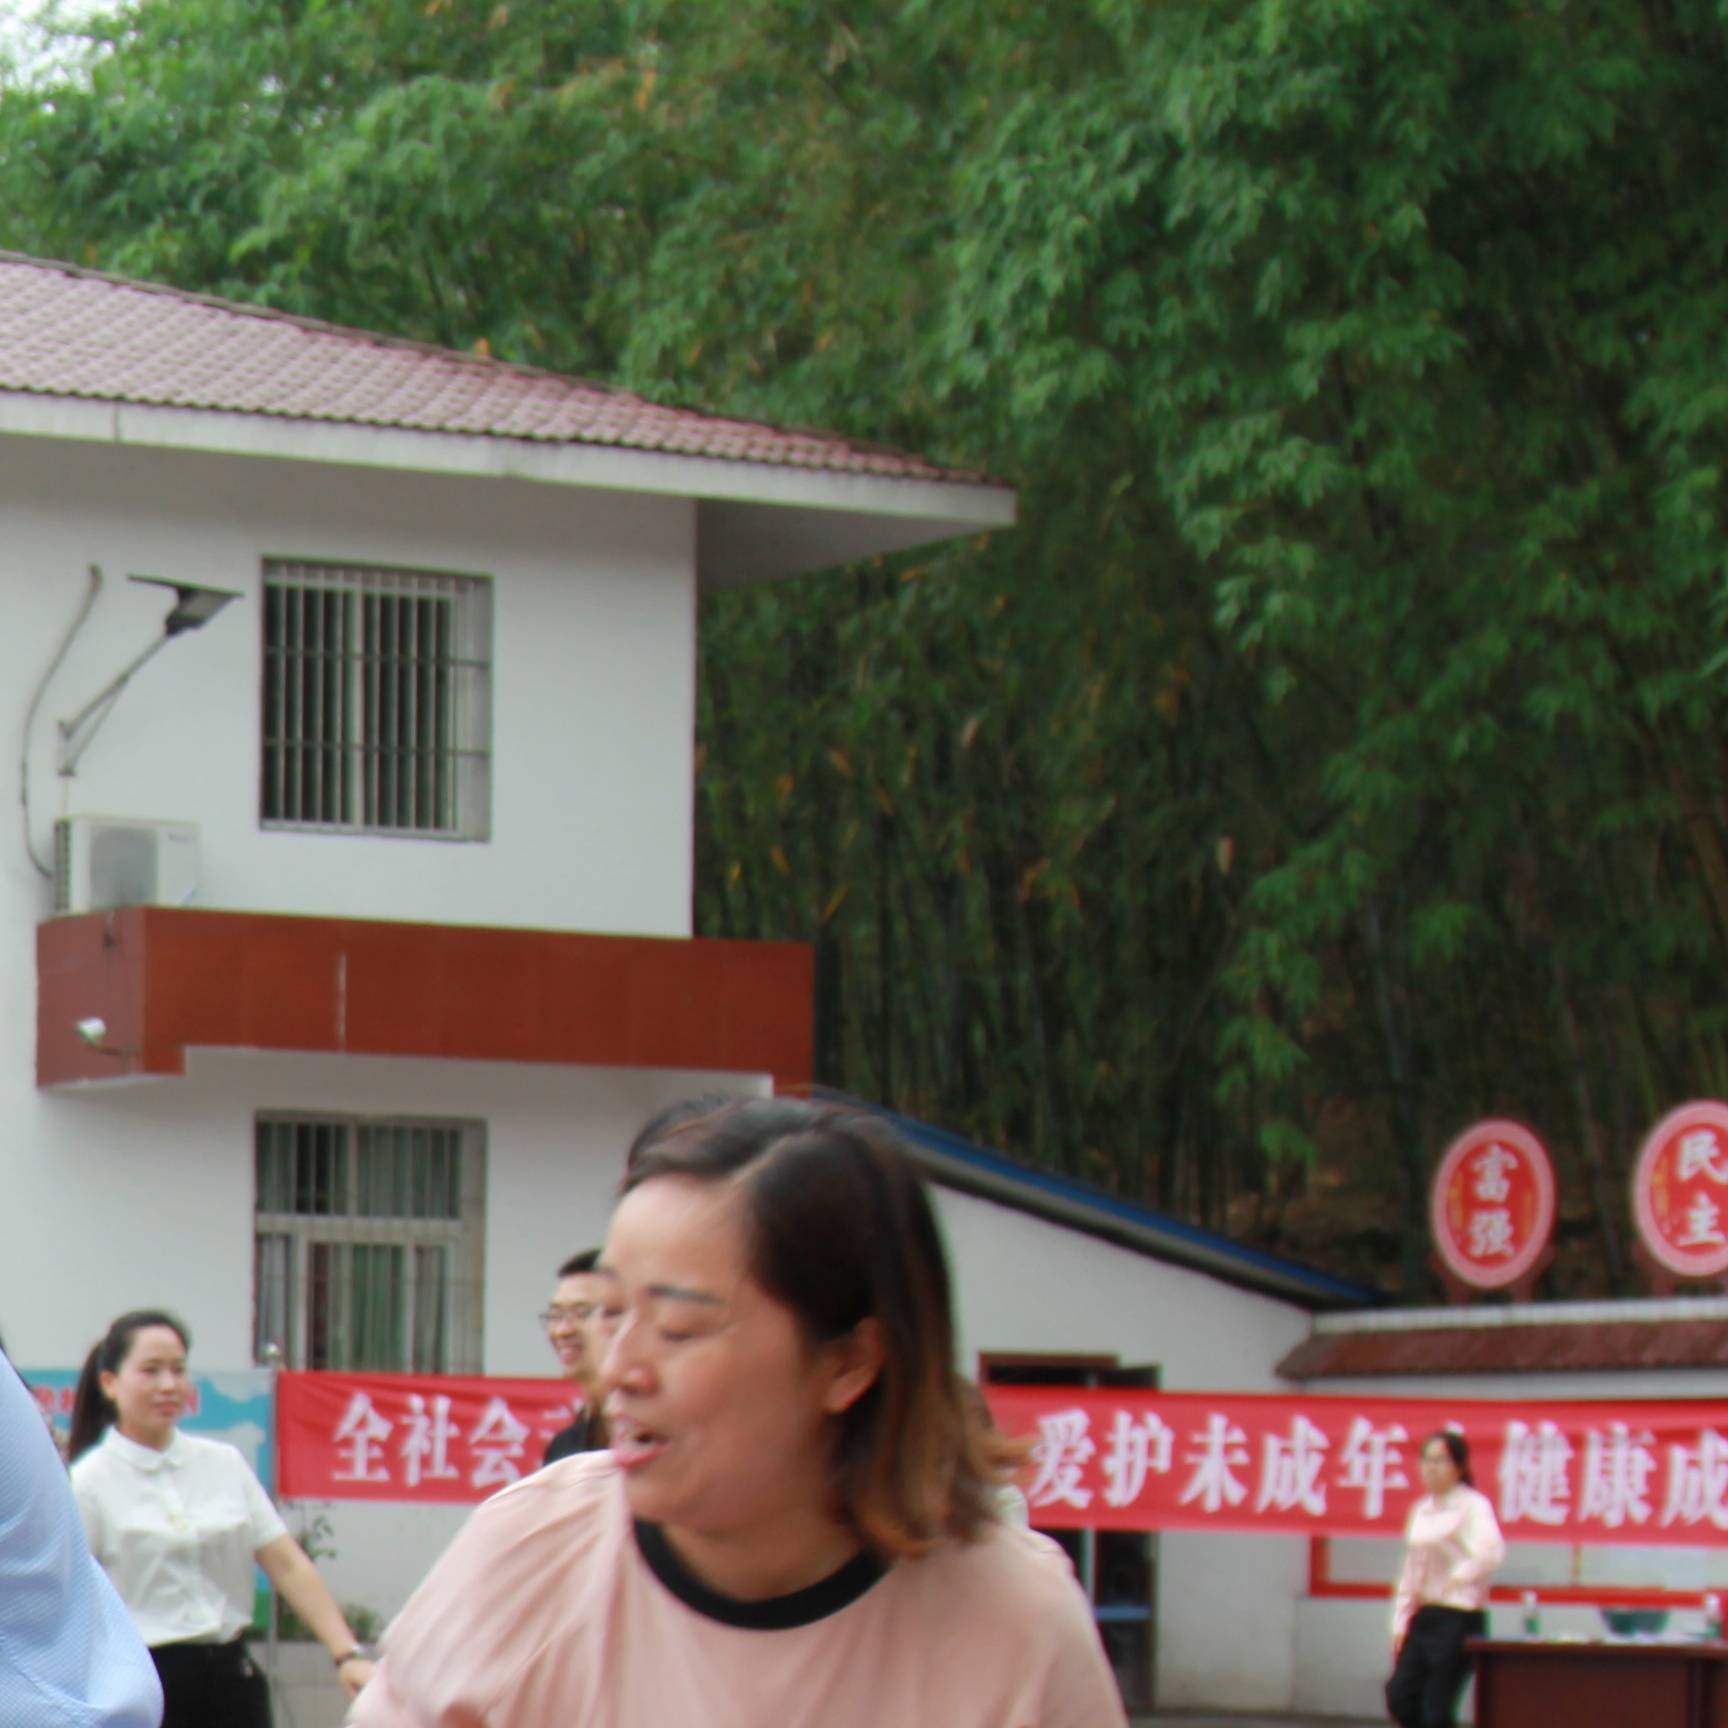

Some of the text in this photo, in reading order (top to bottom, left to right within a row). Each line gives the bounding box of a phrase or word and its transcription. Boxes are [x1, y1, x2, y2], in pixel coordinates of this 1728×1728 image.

[1469, 1143, 1519, 1257] 富强
[1676, 1129, 1728, 1247] 民主
[1030, 1408, 1728, 1529] 爱护未成年健康成
